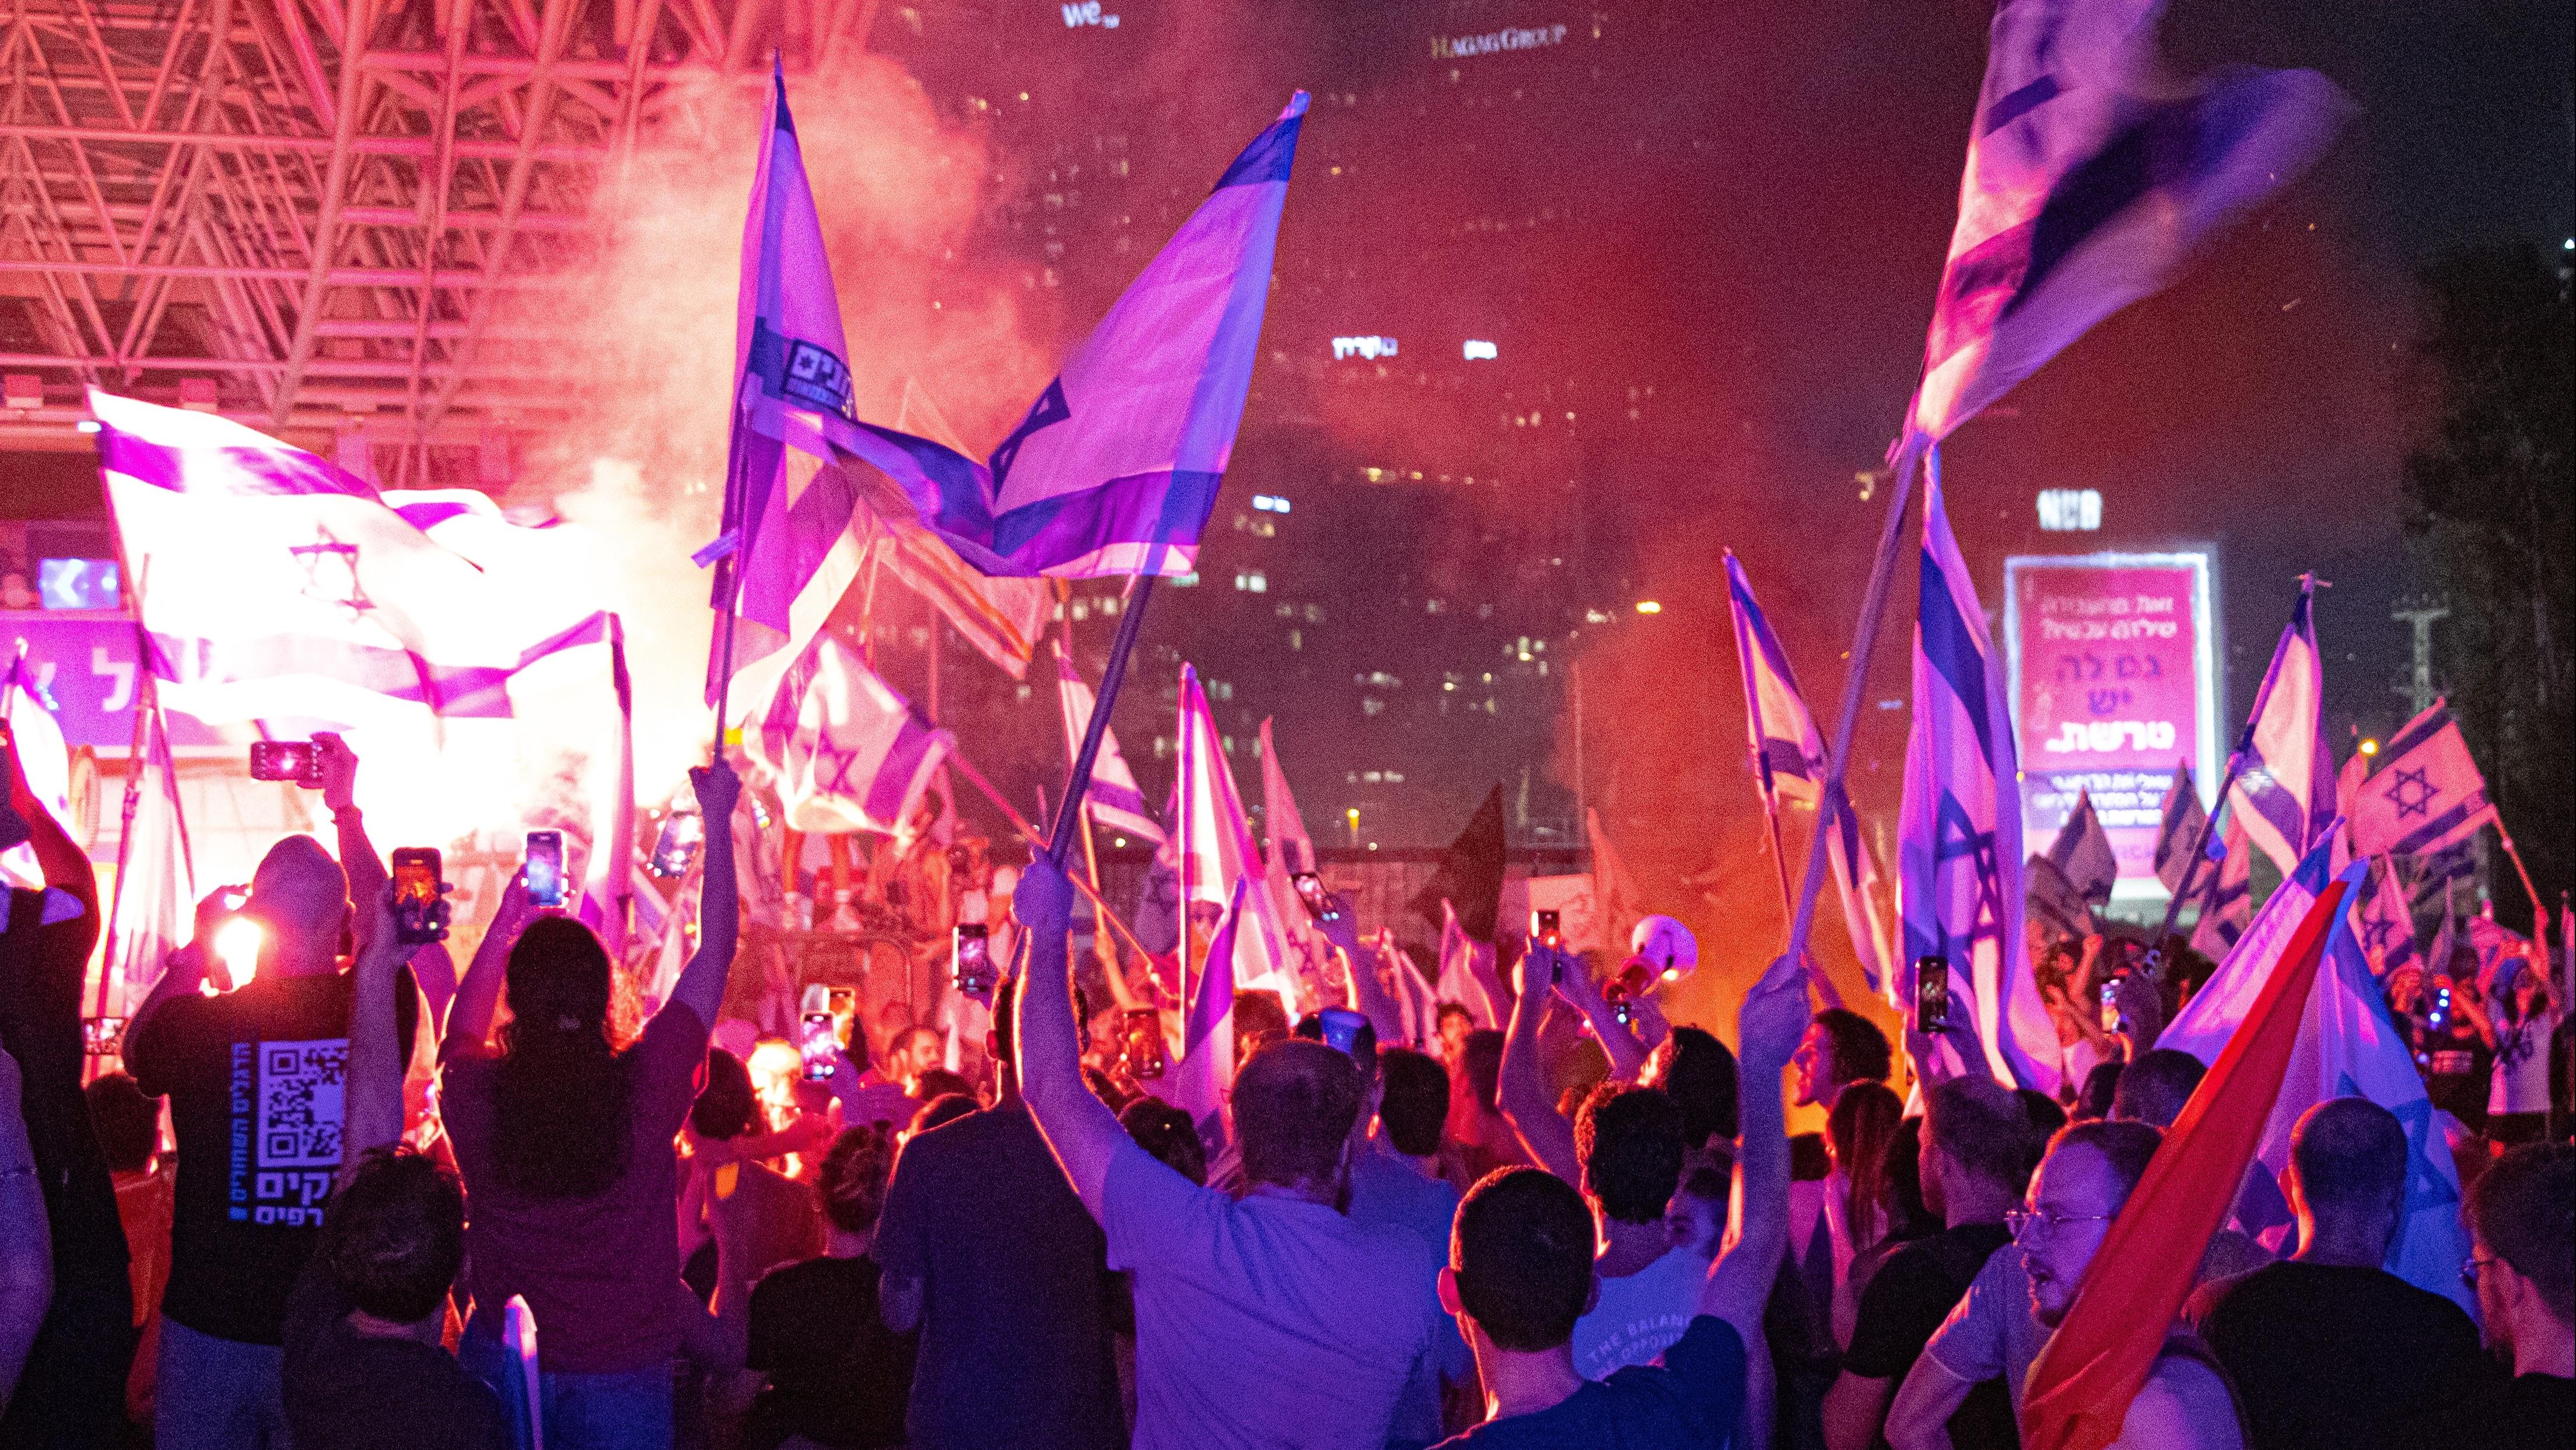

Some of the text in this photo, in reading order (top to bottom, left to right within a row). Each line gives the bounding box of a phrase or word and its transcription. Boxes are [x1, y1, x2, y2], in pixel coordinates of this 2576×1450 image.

[2055, 650, 2165, 683] גם לה
[2088, 689, 2133, 717] יש
[256, 1172, 338, 1206] קים
[1586, 1332, 1622, 1363] THE
